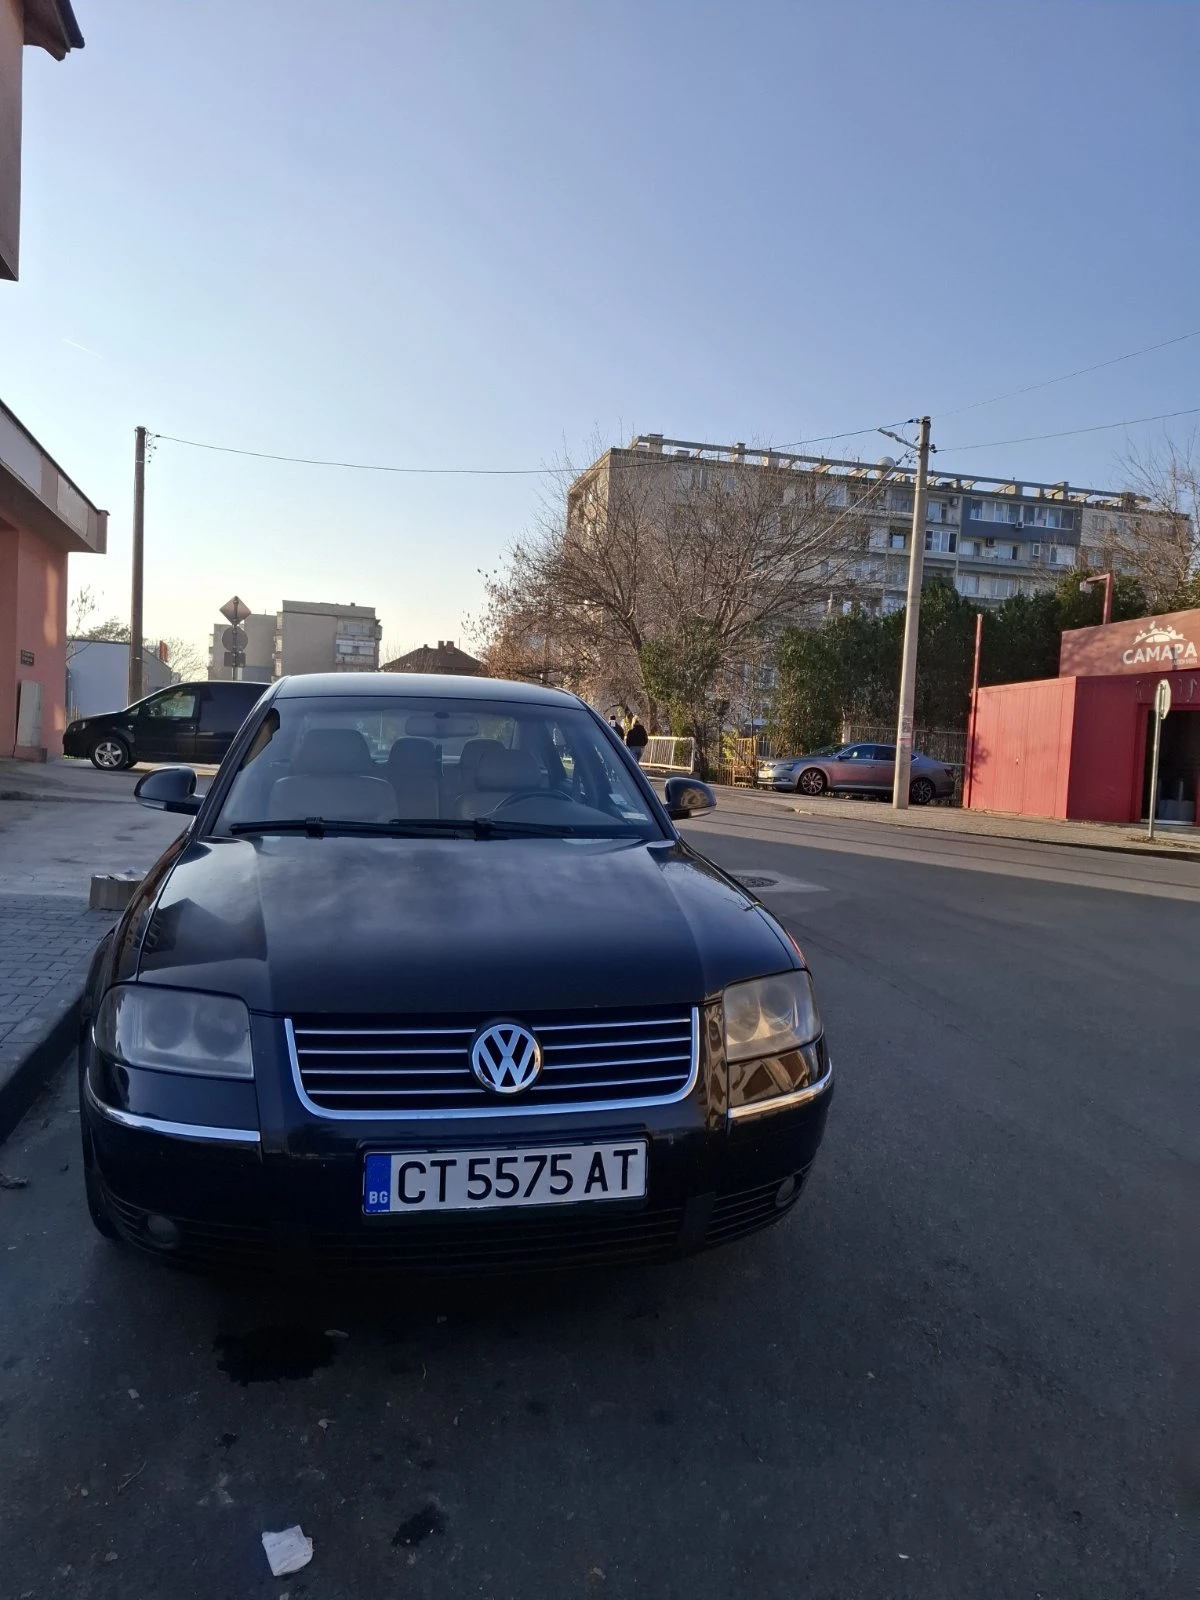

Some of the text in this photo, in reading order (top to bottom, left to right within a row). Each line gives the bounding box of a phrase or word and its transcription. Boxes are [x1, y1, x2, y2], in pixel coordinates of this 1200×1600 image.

[1122, 641, 1198, 665] САМАРА
[398, 1149, 639, 1204] CT 5575 AT
[369, 1190, 389, 1205] BG
